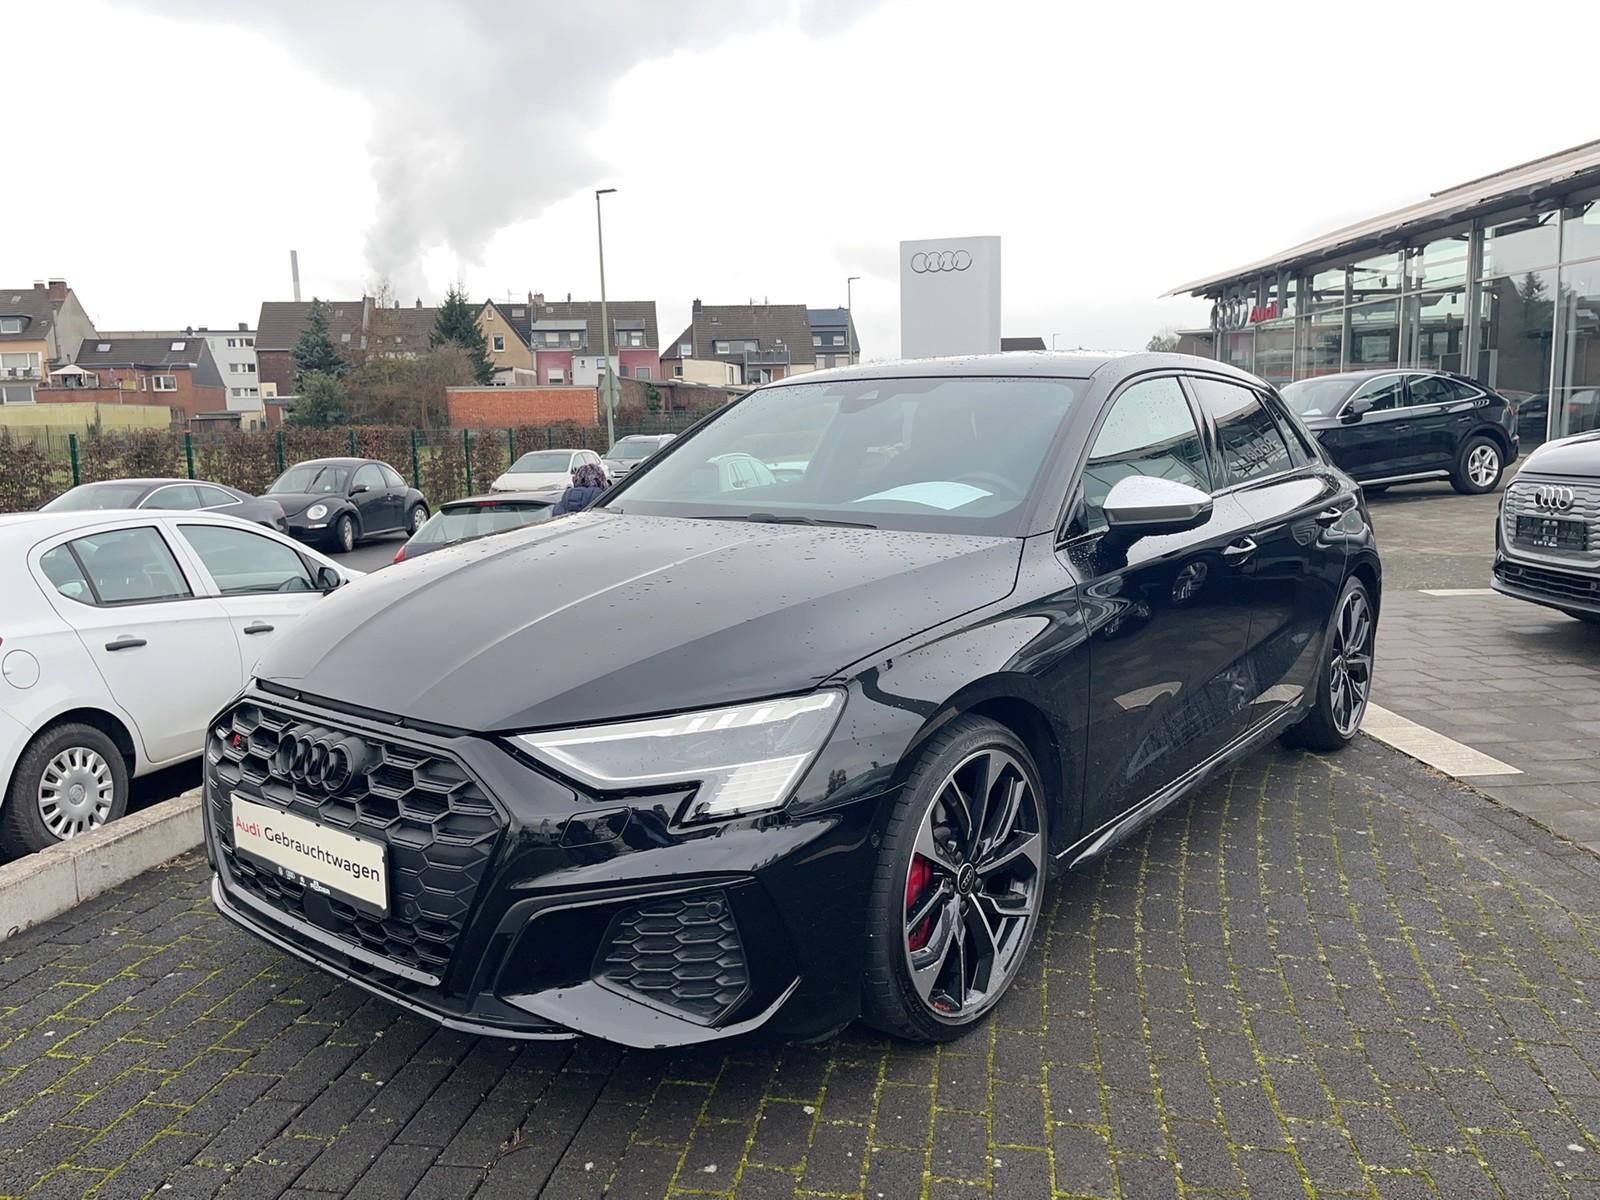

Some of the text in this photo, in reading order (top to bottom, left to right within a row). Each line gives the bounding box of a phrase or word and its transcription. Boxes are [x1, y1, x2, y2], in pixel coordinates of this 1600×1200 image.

[1249, 301, 1277, 323] Audi
[236, 816, 261, 837] Audi
[264, 827, 380, 882] Gebrauchtwagen
